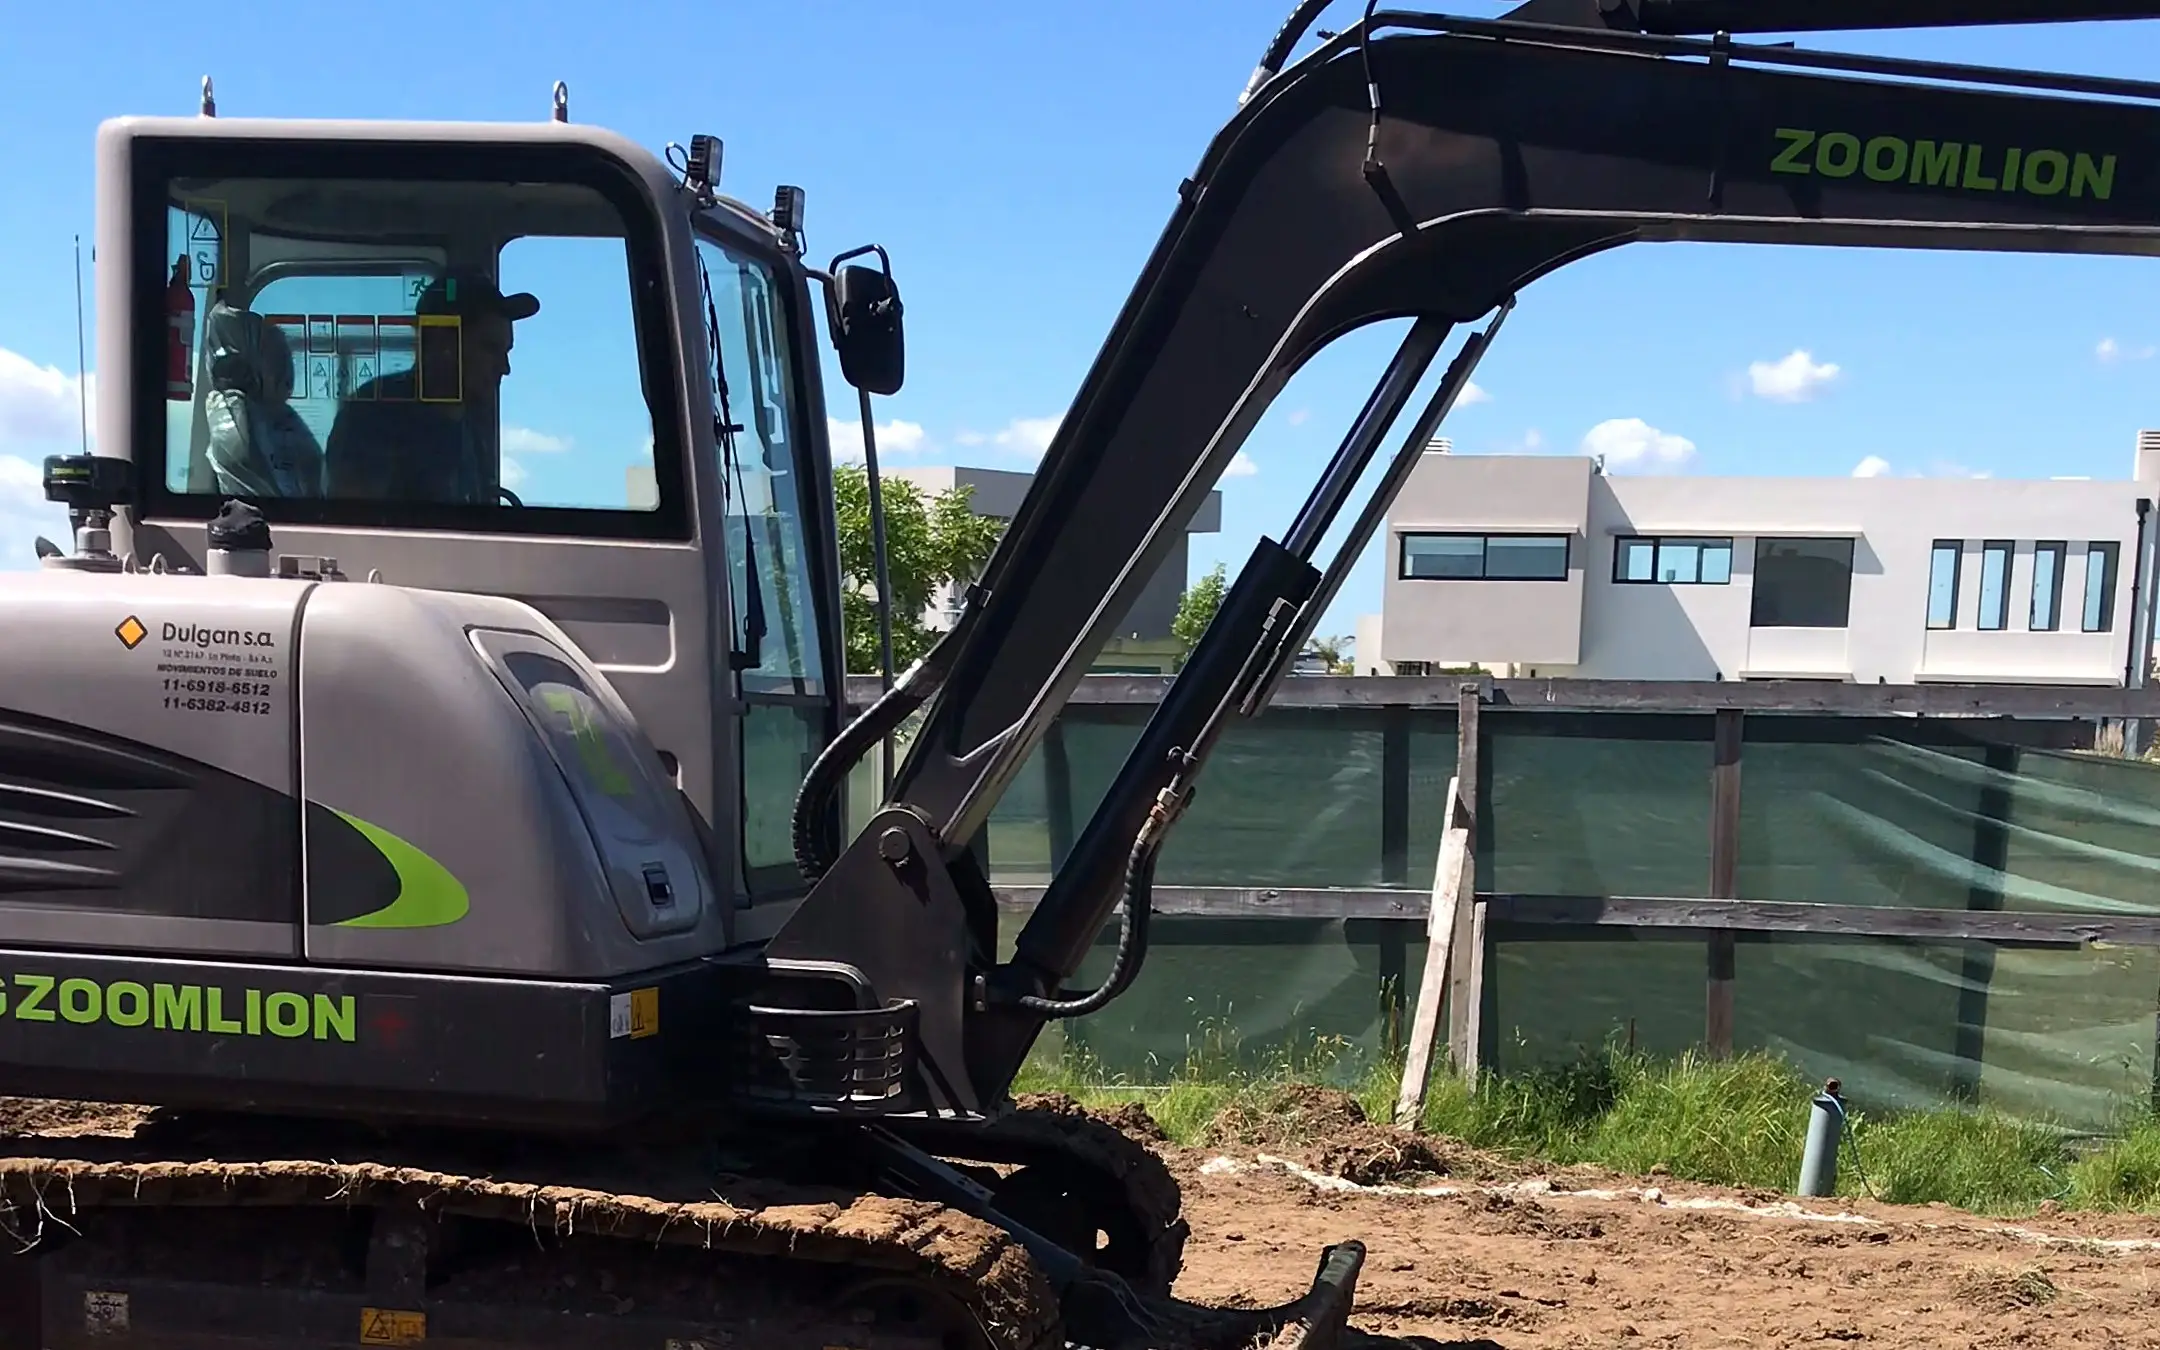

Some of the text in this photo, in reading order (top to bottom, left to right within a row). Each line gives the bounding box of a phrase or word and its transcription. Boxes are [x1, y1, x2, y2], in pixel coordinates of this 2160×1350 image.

[1770, 128, 2116, 199] ZOOMLION
[162, 622, 239, 648] Dulgan
[229, 665, 242, 677] DE
[244, 667, 277, 678] SUELO
[163, 678, 270, 696] 11-6918-6512
[163, 697, 270, 715] 11-6382-4812
[15, 974, 356, 1041] ZOOMLION
